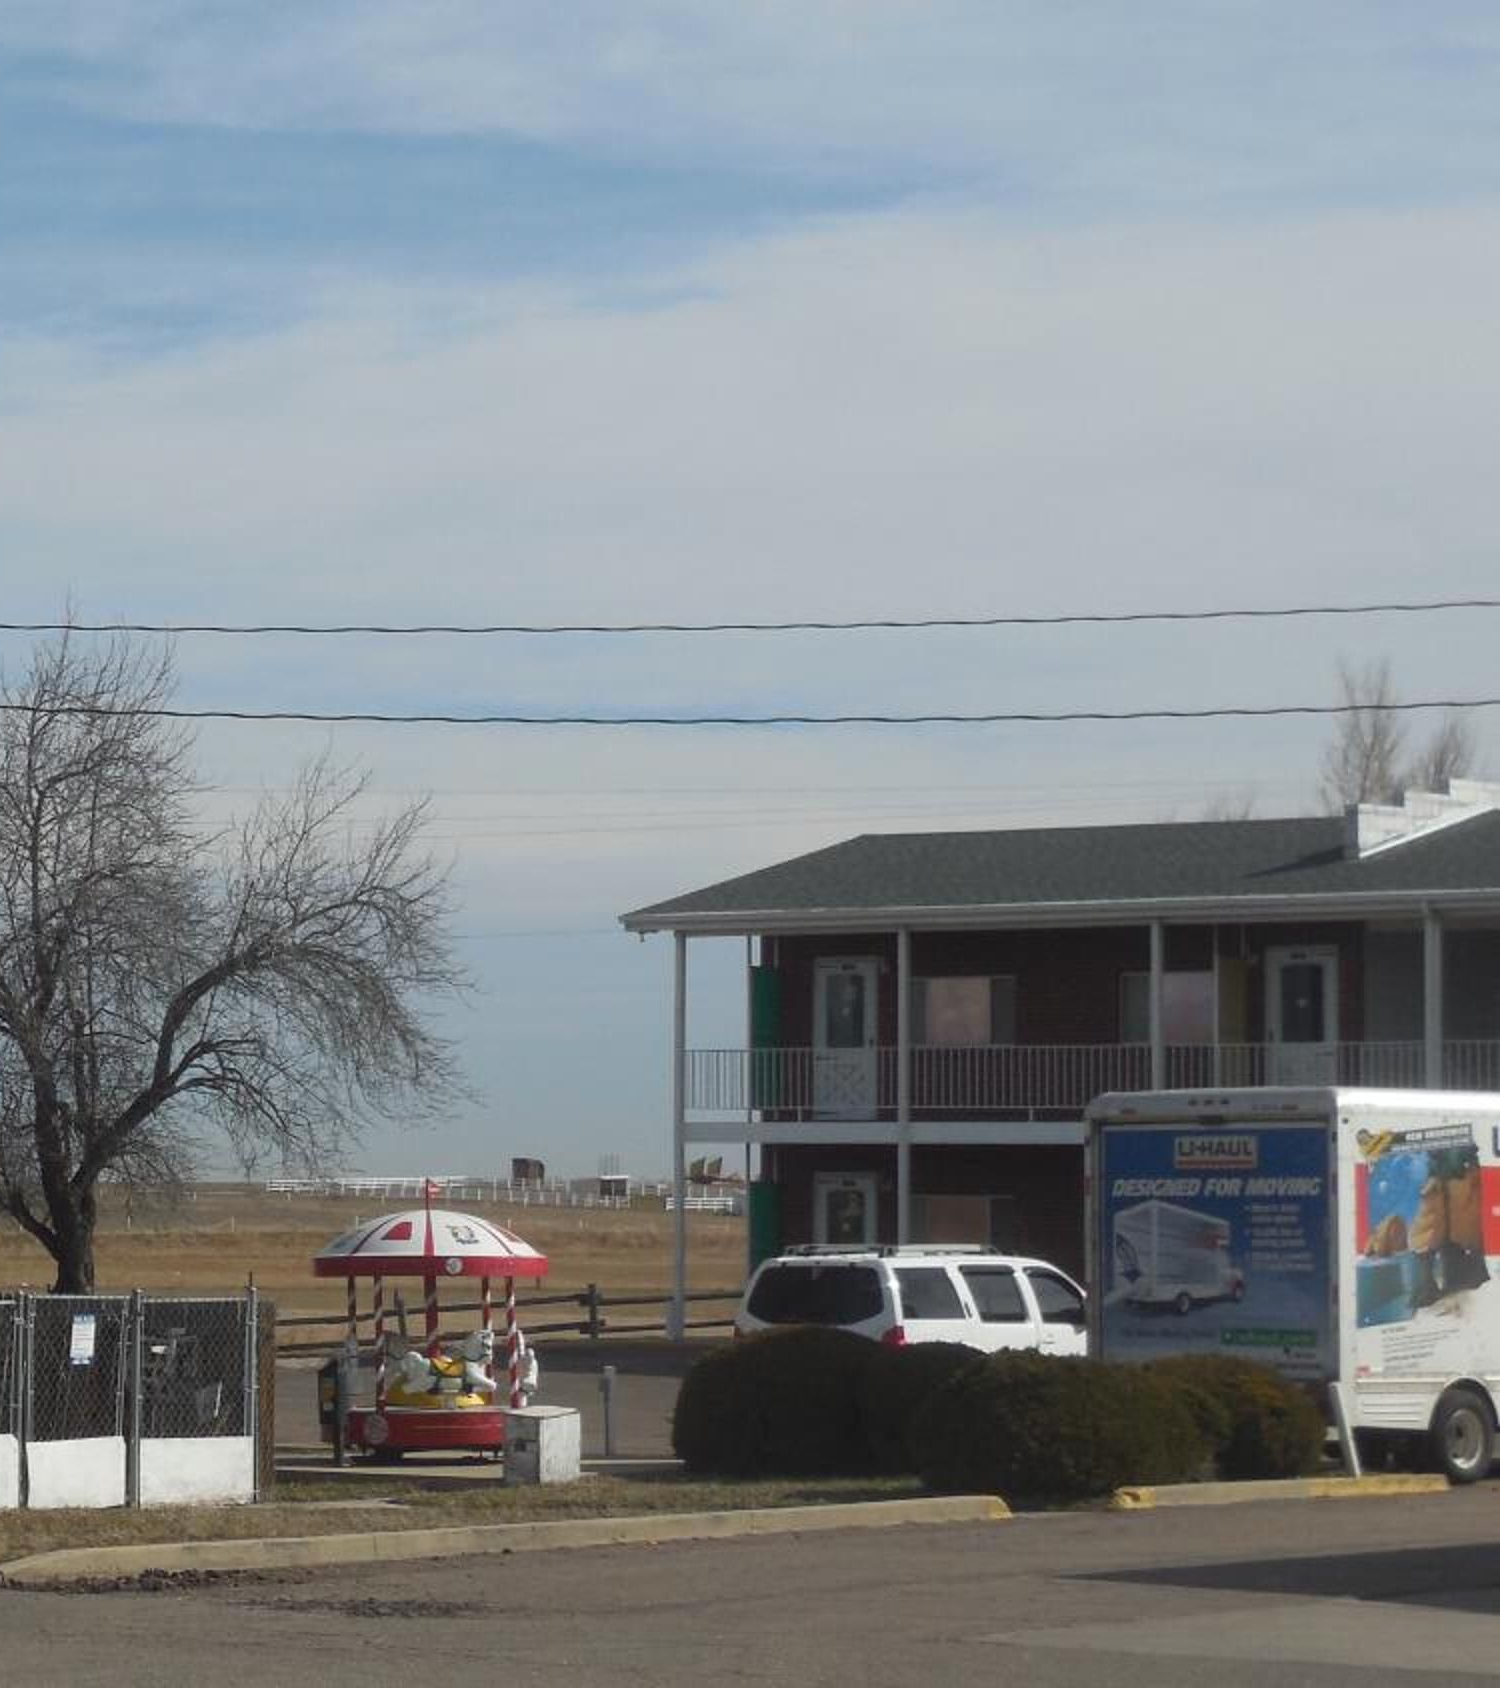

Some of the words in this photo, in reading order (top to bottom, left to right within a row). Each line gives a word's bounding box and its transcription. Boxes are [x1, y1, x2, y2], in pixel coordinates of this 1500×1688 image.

[1177, 1138, 1253, 1157] U-HAUL
[1111, 1178, 1200, 1197] DESIGNED
[1202, 1177, 1241, 1197] FOR
[1243, 1176, 1323, 1197] MOVING
